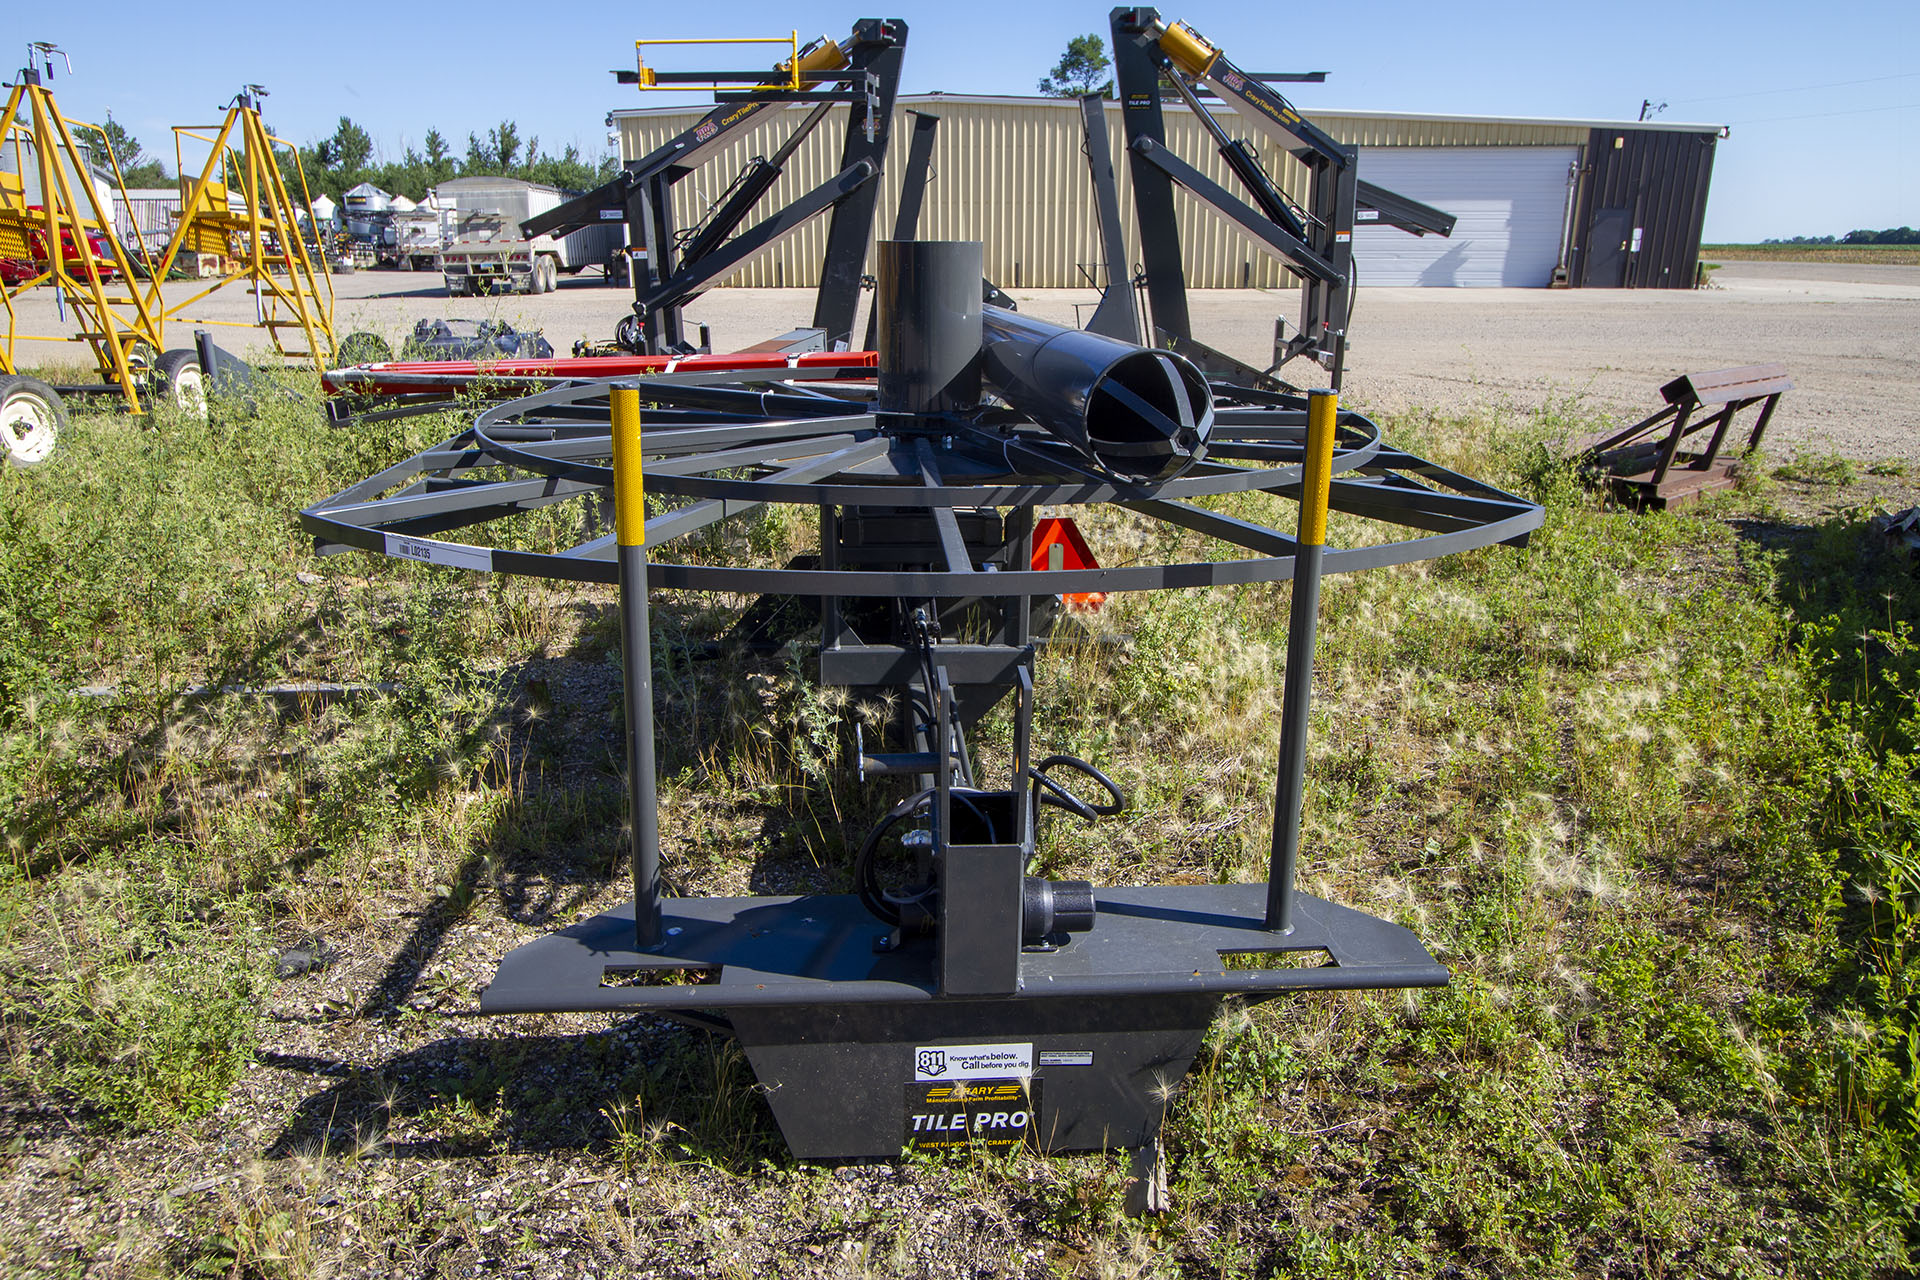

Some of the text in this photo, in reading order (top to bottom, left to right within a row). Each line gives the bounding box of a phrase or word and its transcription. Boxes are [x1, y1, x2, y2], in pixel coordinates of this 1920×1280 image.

[1245, 90, 1290, 125] CraryTilePro.com
[411, 545, 430, 559] L02135
[919, 1051, 945, 1067] 811
[990, 1052, 1018, 1061] below.
[961, 1061, 980, 1070] Call
[1003, 1061, 1018, 1070] you
[912, 1111, 1028, 1132] TILE PRO
